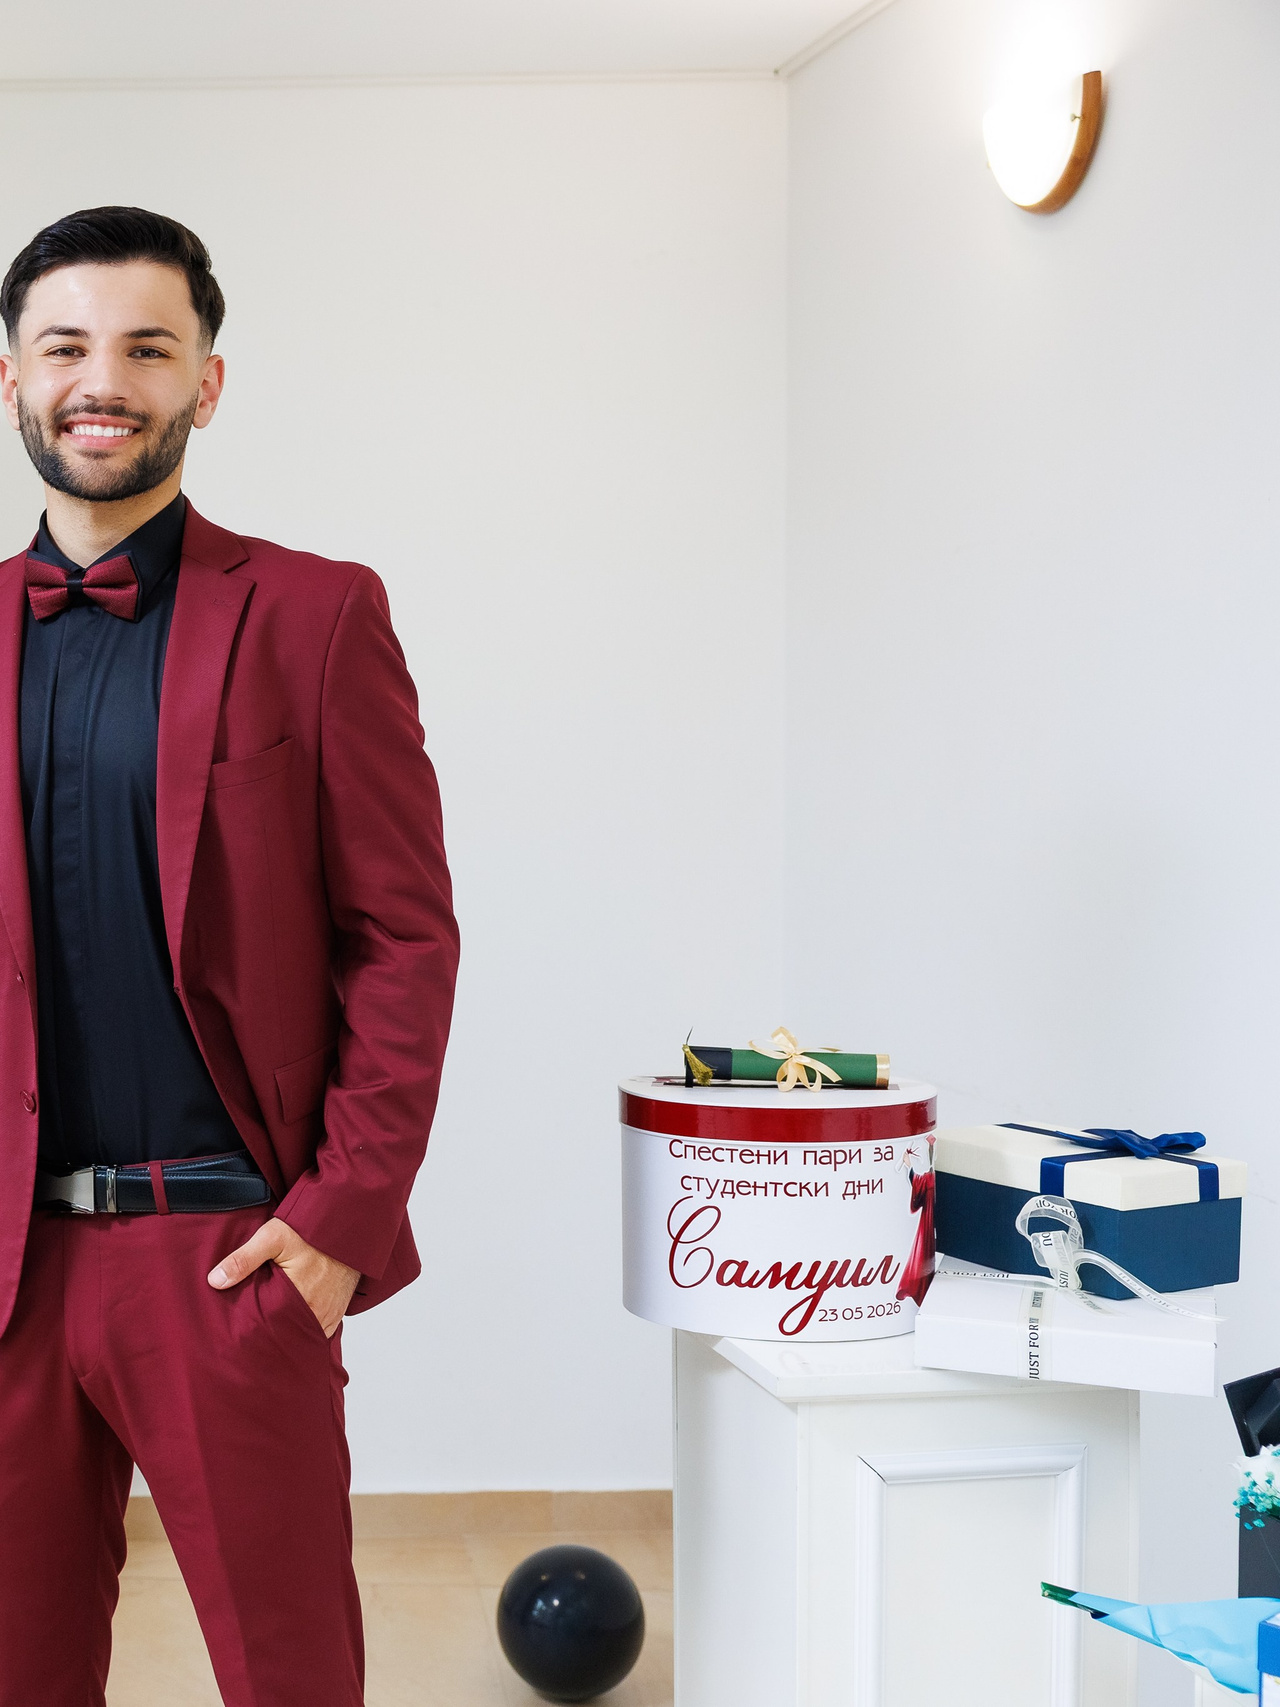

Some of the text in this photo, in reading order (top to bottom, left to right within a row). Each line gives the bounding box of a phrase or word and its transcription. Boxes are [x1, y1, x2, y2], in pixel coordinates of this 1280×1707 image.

[668, 1138, 895, 1172] Спестени пари за
[680, 1174, 884, 1201] студентски дни
[666, 1195, 901, 1336] Самуил
[818, 1300, 902, 1322] 23 05 2026
[1028, 1324, 1040, 1349] FOR
[1028, 1351, 1040, 1379] JUST
